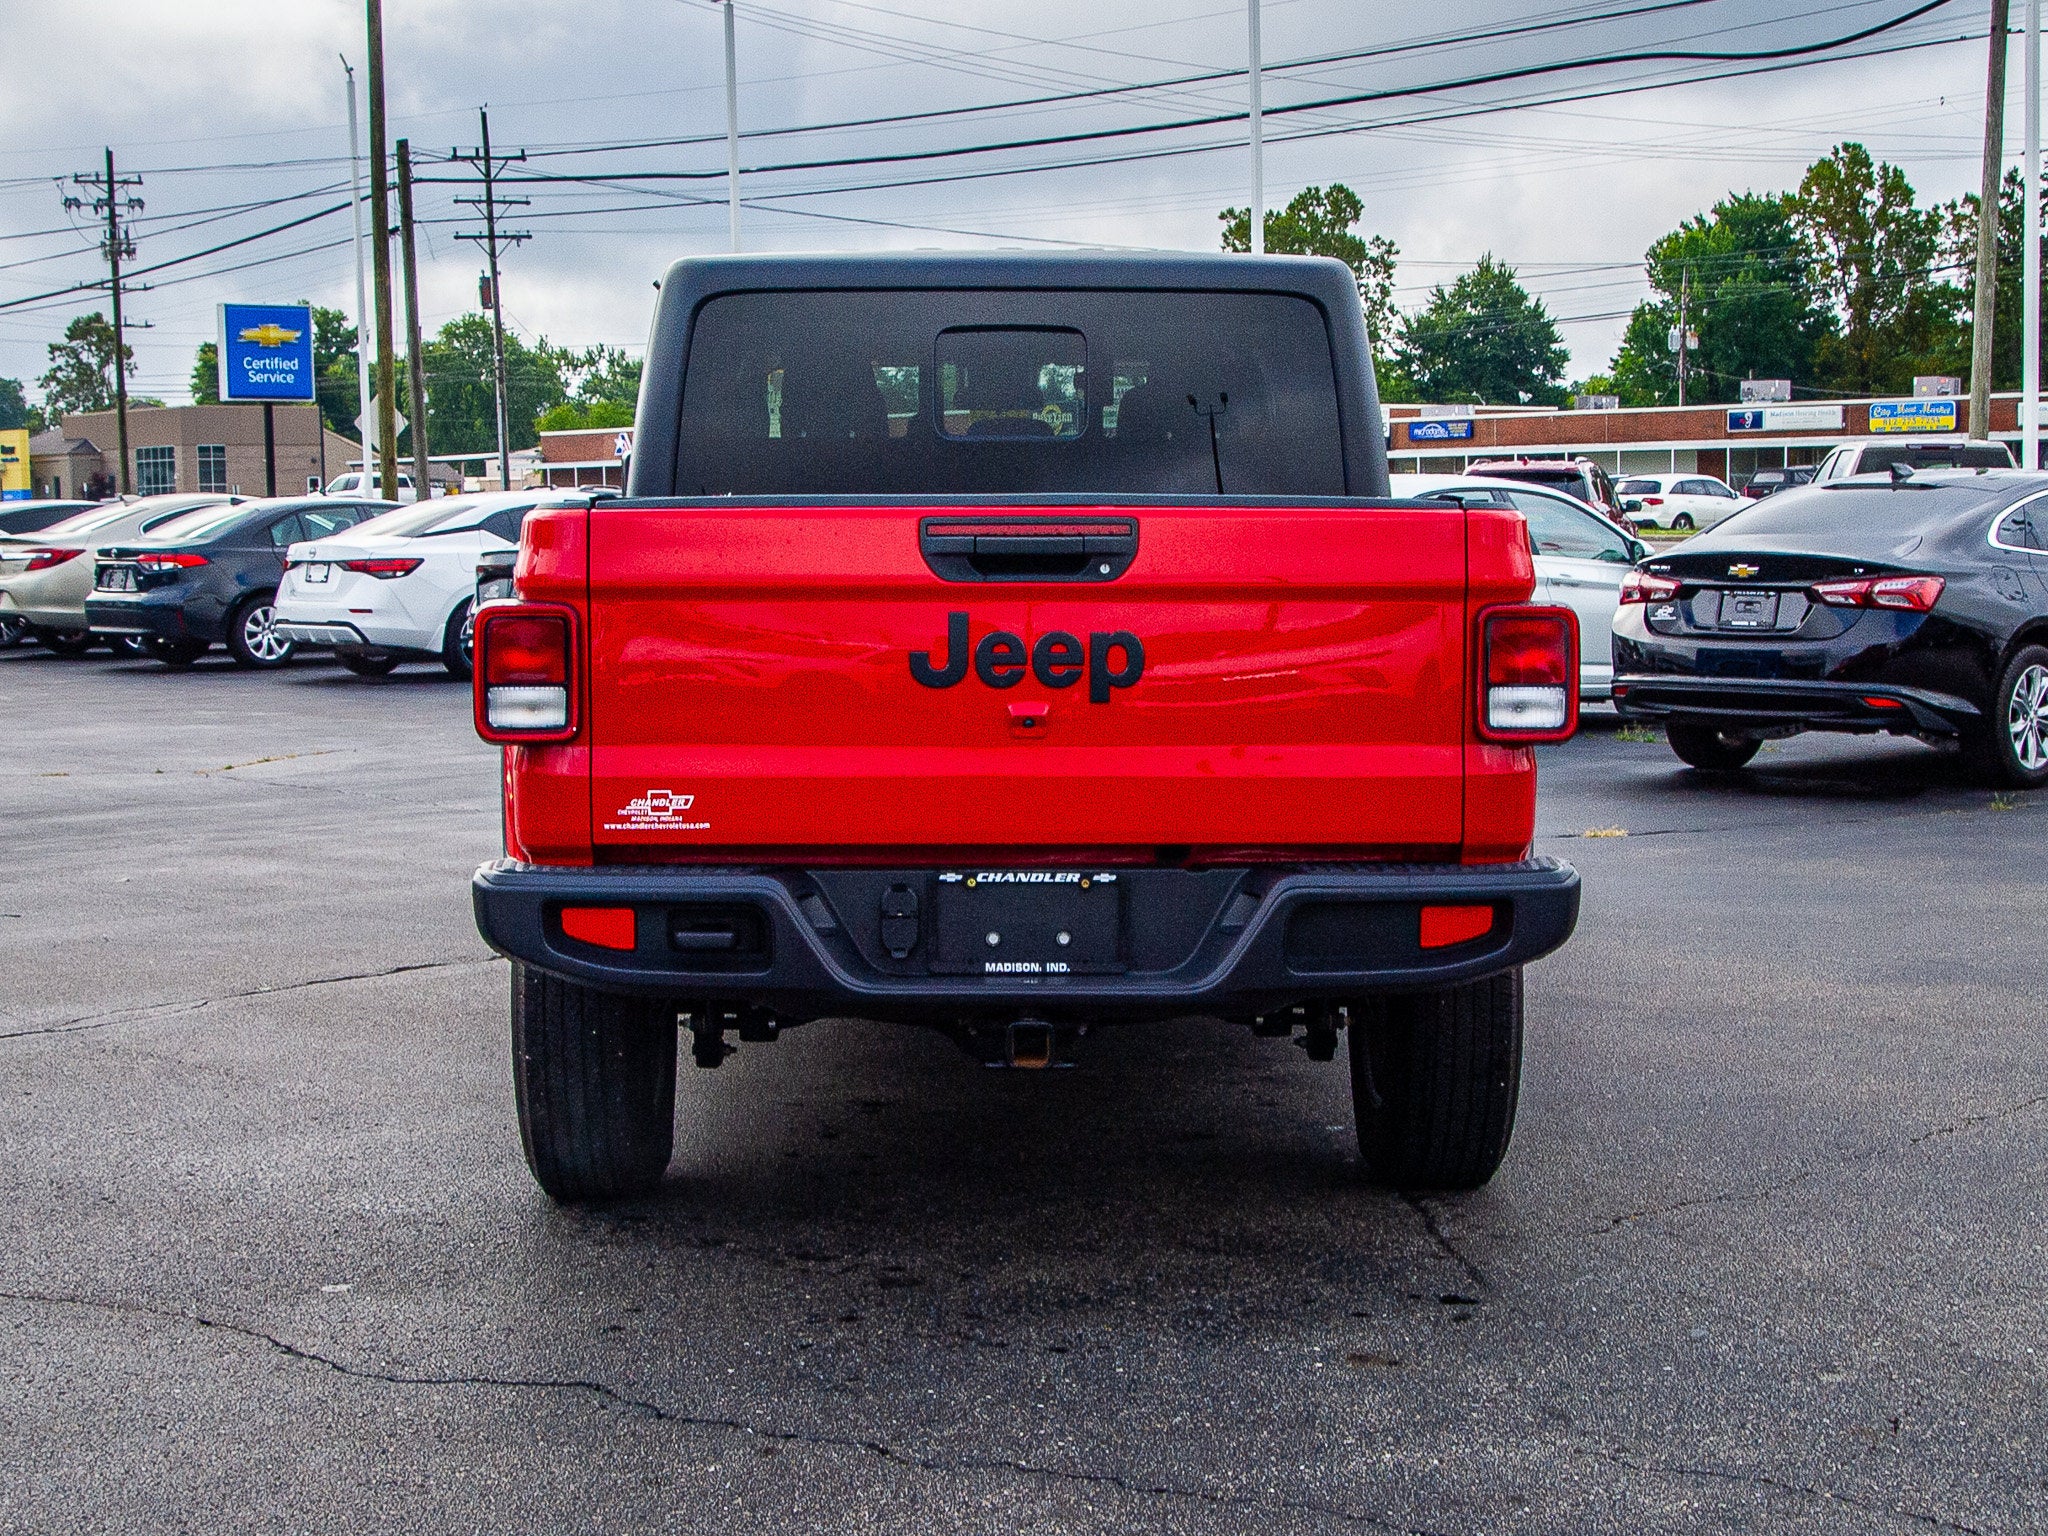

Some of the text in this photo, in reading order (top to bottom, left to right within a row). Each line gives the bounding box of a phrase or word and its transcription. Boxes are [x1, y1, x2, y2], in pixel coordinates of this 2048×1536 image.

[243, 357, 299, 370] Certified
[248, 371, 295, 383] Service
[1873, 406, 1891, 417] City
[1919, 402, 1951, 414] Market
[909, 612, 1146, 703] Jeep
[630, 798, 686, 807] CHANDLER
[603, 822, 711, 830] www.chandlerchevroletusa.com
[976, 872, 1081, 883] CHANDLER
[1046, 962, 1071, 973] IND.
